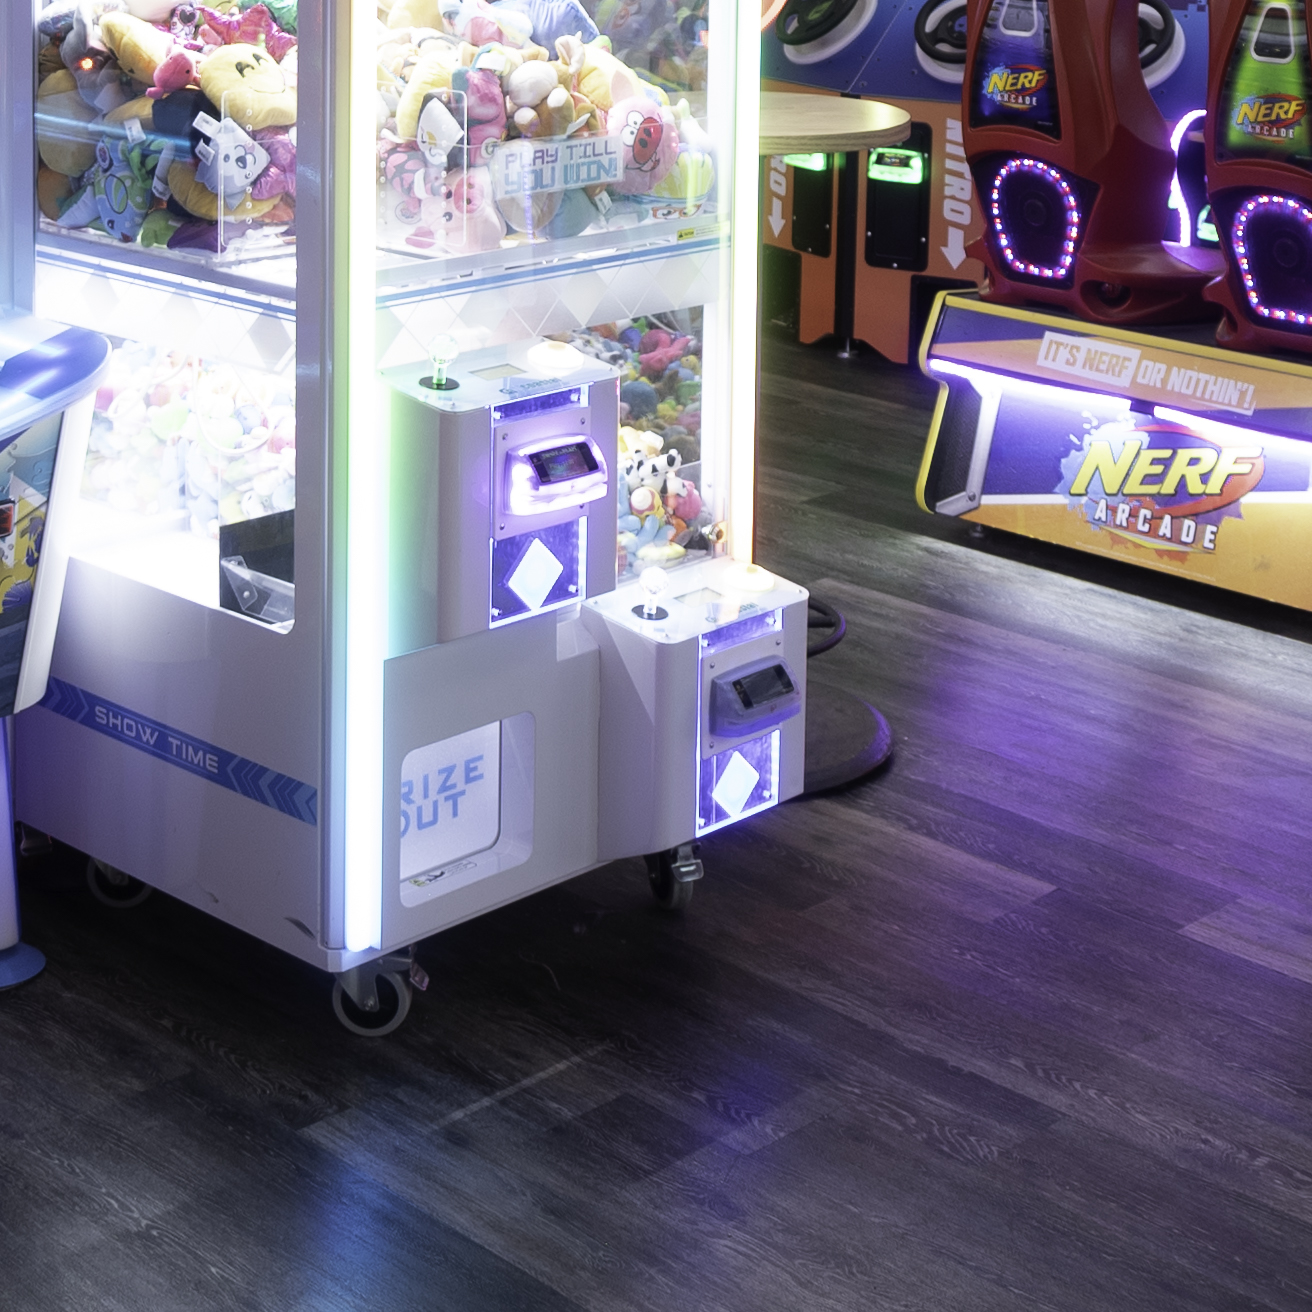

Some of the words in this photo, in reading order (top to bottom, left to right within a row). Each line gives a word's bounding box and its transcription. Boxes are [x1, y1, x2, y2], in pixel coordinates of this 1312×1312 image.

[987, 69, 1047, 94] NERF
[997, 93, 1038, 106] ARCADE
[1236, 99, 1306, 125] NERF
[1248, 124, 1295, 139] ARCADE
[504, 146, 559, 170] PLAY
[565, 139, 617, 161] TILL
[942, 117, 973, 226] NITRO
[503, 167, 557, 196] YOU
[563, 156, 619, 186] WIN!
[1043, 339, 1081, 368] IT'S
[1081, 347, 1133, 378] NERF
[1136, 358, 1168, 388] OR
[1166, 365, 1256, 409] NOTHIN'!
[1068, 438, 1266, 498] NERF
[1092, 498, 1218, 551] ARCADE
[94, 704, 160, 746] SHOW
[167, 735, 220, 774] TIME
